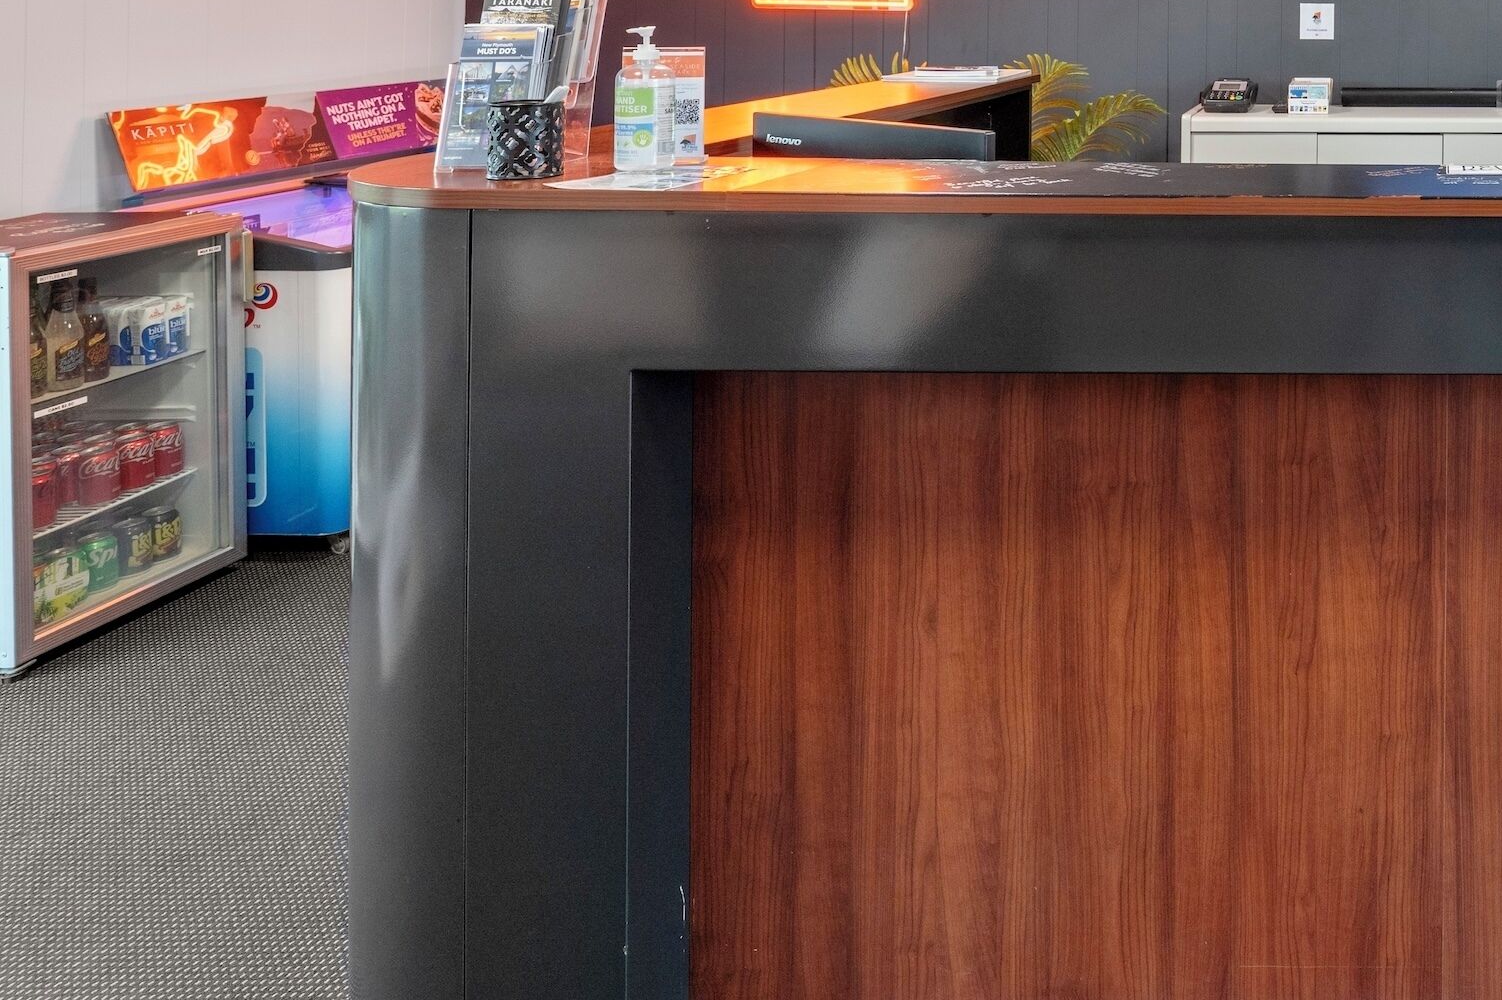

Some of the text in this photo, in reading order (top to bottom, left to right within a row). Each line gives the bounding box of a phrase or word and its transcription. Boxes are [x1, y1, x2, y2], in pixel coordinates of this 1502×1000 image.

[499, 47, 517, 55] DO'S
[326, 92, 404, 116] NUTS AIN'T GOT
[616, 97, 636, 105] AND
[332, 102, 406, 125] NOTHING ON A
[347, 122, 406, 141] UNLESS THEY'RE
[348, 114, 397, 132] TRUMPET.
[352, 139, 366, 147] ON
[372, 130, 407, 144] TRUMPET.
[766, 133, 802, 146] lenovo
